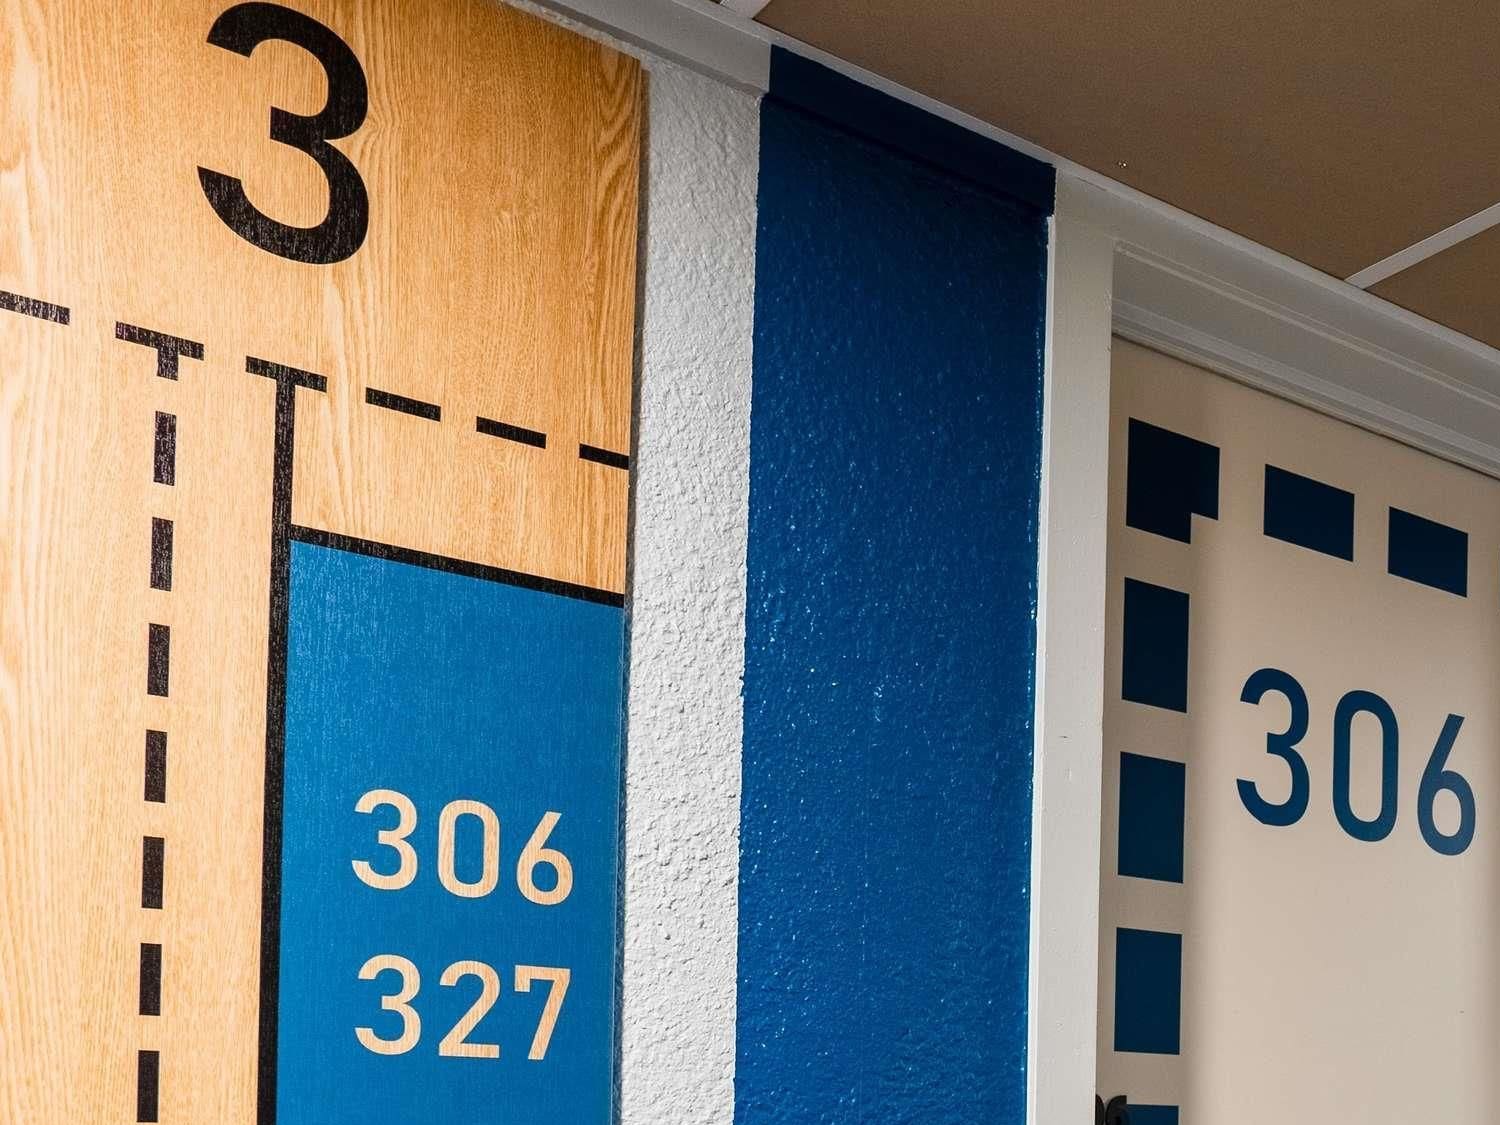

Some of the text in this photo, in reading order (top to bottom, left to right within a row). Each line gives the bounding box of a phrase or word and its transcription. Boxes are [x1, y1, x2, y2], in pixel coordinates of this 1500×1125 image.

[197, 1, 370, 265] 3
[1236, 667, 1476, 856] 306
[351, 789, 574, 906] 306
[355, 954, 572, 1060] 327
